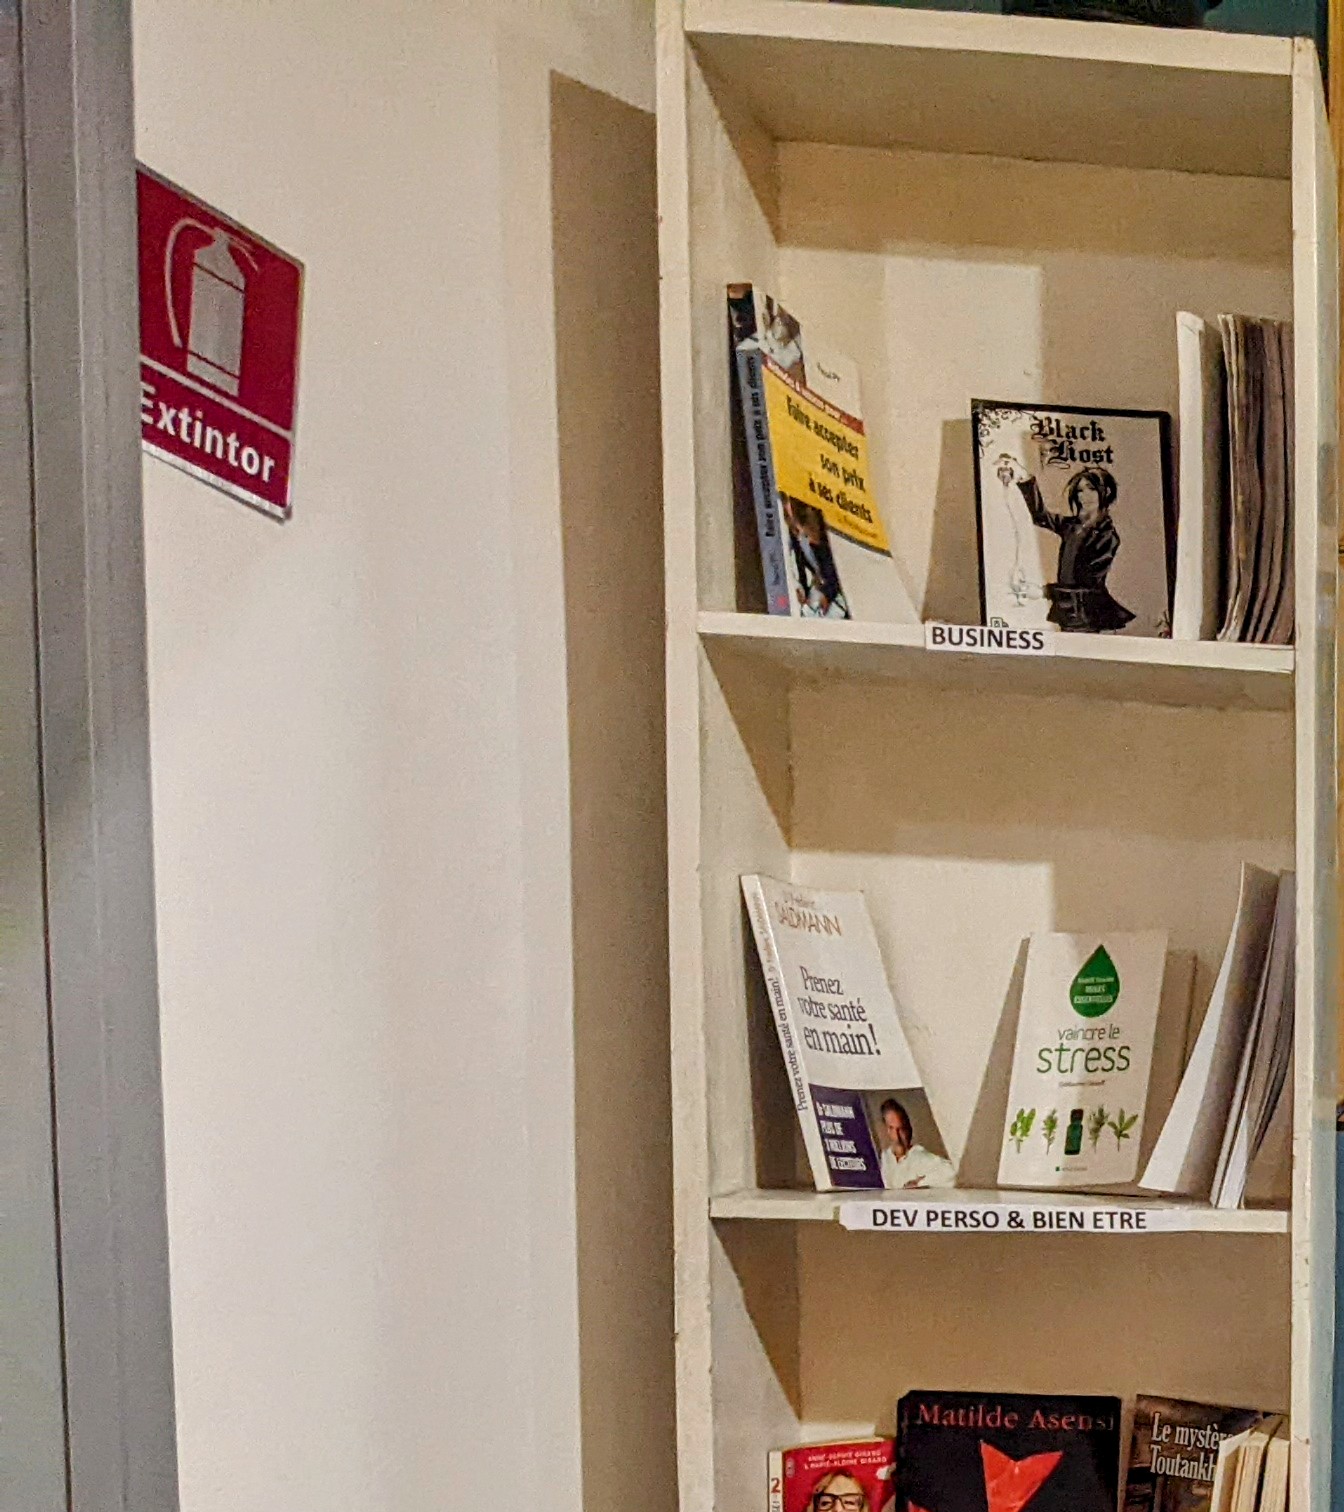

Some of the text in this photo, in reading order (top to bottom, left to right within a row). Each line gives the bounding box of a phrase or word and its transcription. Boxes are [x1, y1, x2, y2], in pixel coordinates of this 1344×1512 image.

[140, 380, 275, 483] Extintor
[1030, 416, 1105, 442] Black
[820, 453, 865, 493] son prix
[836, 491, 873, 524] clients
[931, 626, 1044, 650] BUSINESS
[799, 965, 844, 995] Prenez
[776, 1007, 788, 1023] en
[798, 996, 868, 1022] votre santé
[779, 1023, 794, 1050] santé
[804, 1023, 882, 1056] en main!
[1058, 1023, 1120, 1041] vaincre le
[789, 1050, 802, 1076] votre
[1036, 1042, 1131, 1074] stress
[795, 1076, 809, 1112] Prenez
[873, 1209, 1147, 1231] DEV PERSO & BIEN ETRE
[919, 1404, 1114, 1431] Matilde Asensi
[1151, 1412, 1171, 1442] Le
[1150, 1444, 1217, 1482] Toutankh
[770, 1477, 781, 1494] 2
